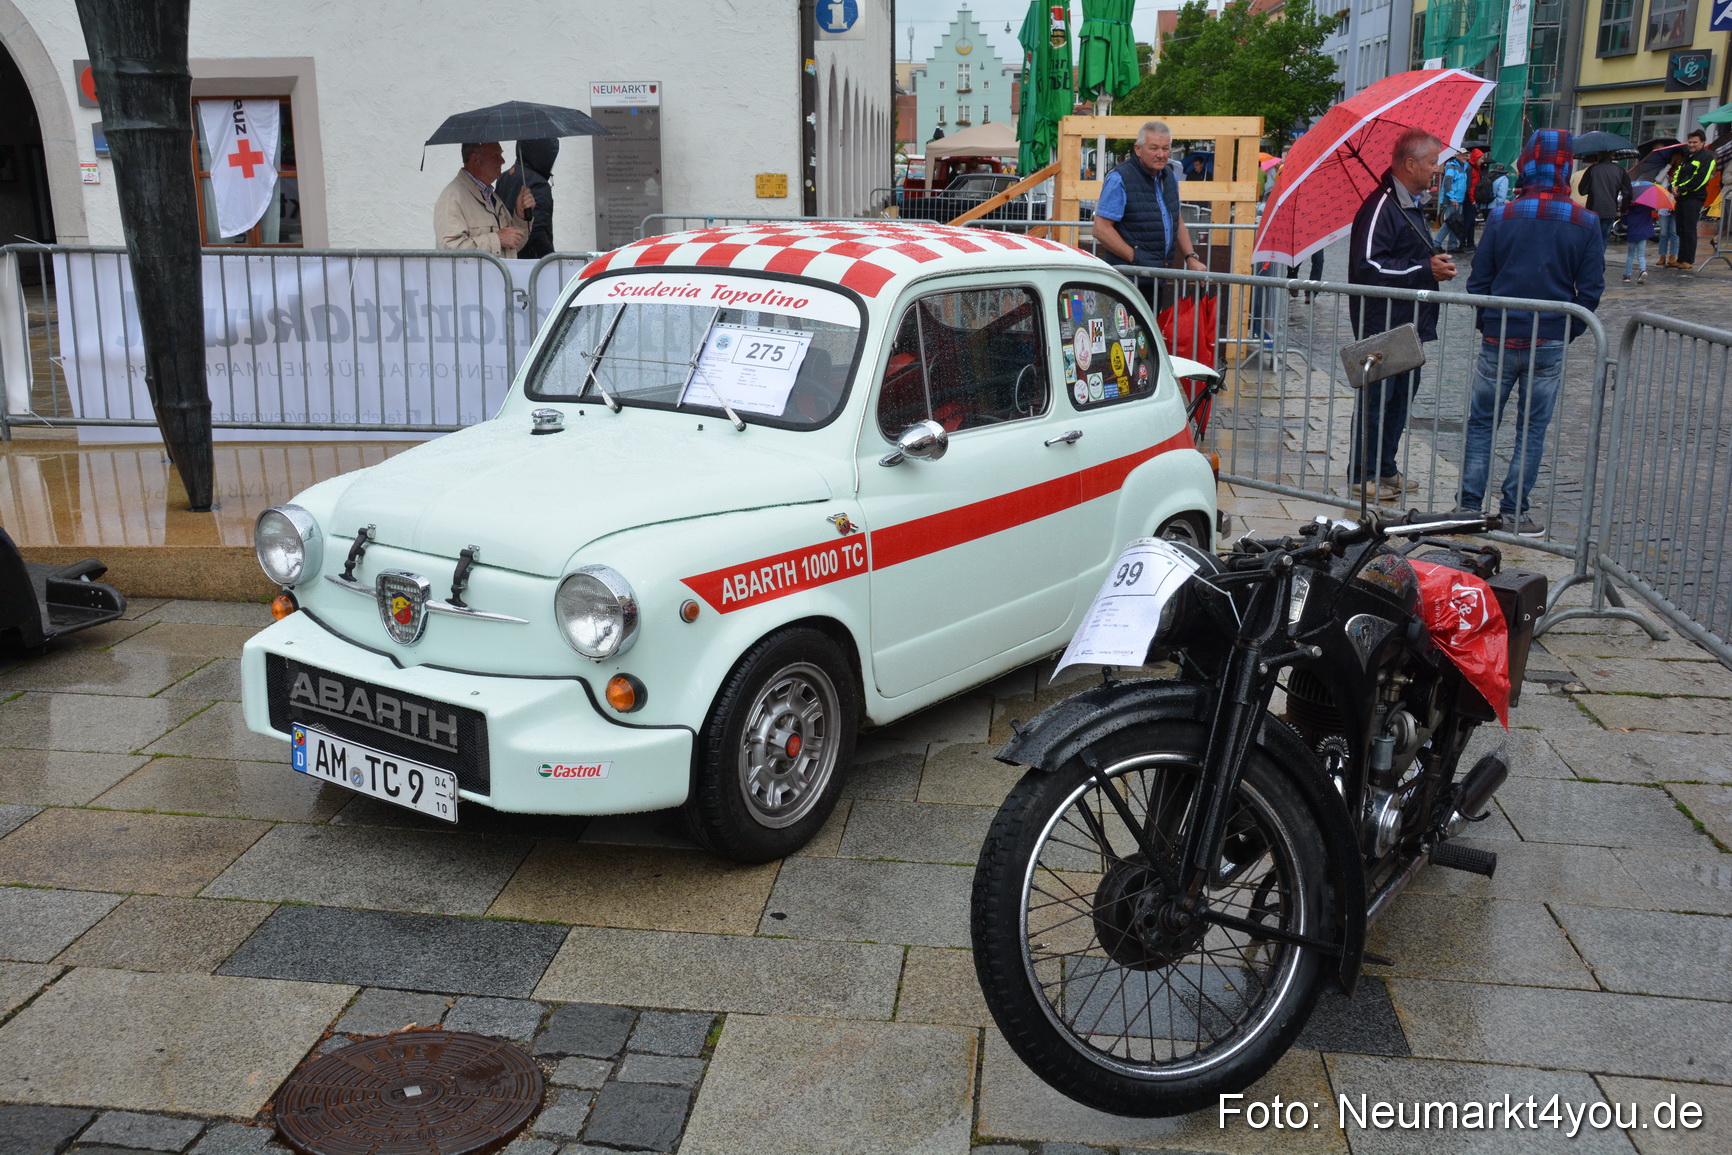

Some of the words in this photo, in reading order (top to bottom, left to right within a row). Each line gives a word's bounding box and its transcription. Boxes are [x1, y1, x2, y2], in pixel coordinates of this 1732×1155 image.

[1684, 61, 1699, 78] G2
[593, 84, 647, 95] NEUMARKT
[607, 281, 701, 298] Scuderia
[710, 284, 809, 309] Topolino
[745, 342, 786, 362] 275
[722, 559, 798, 605] ABARTH
[801, 549, 839, 581] 1000
[841, 542, 864, 570] TC
[1113, 561, 1144, 588] 99
[289, 671, 458, 747] ABARTH
[296, 751, 304, 767] D
[316, 739, 347, 781] AM
[365, 754, 400, 797] TC
[408, 769, 424, 804] 9
[553, 764, 602, 778] Castrol
[434, 776, 447, 789] 04
[436, 801, 448, 814] 10
